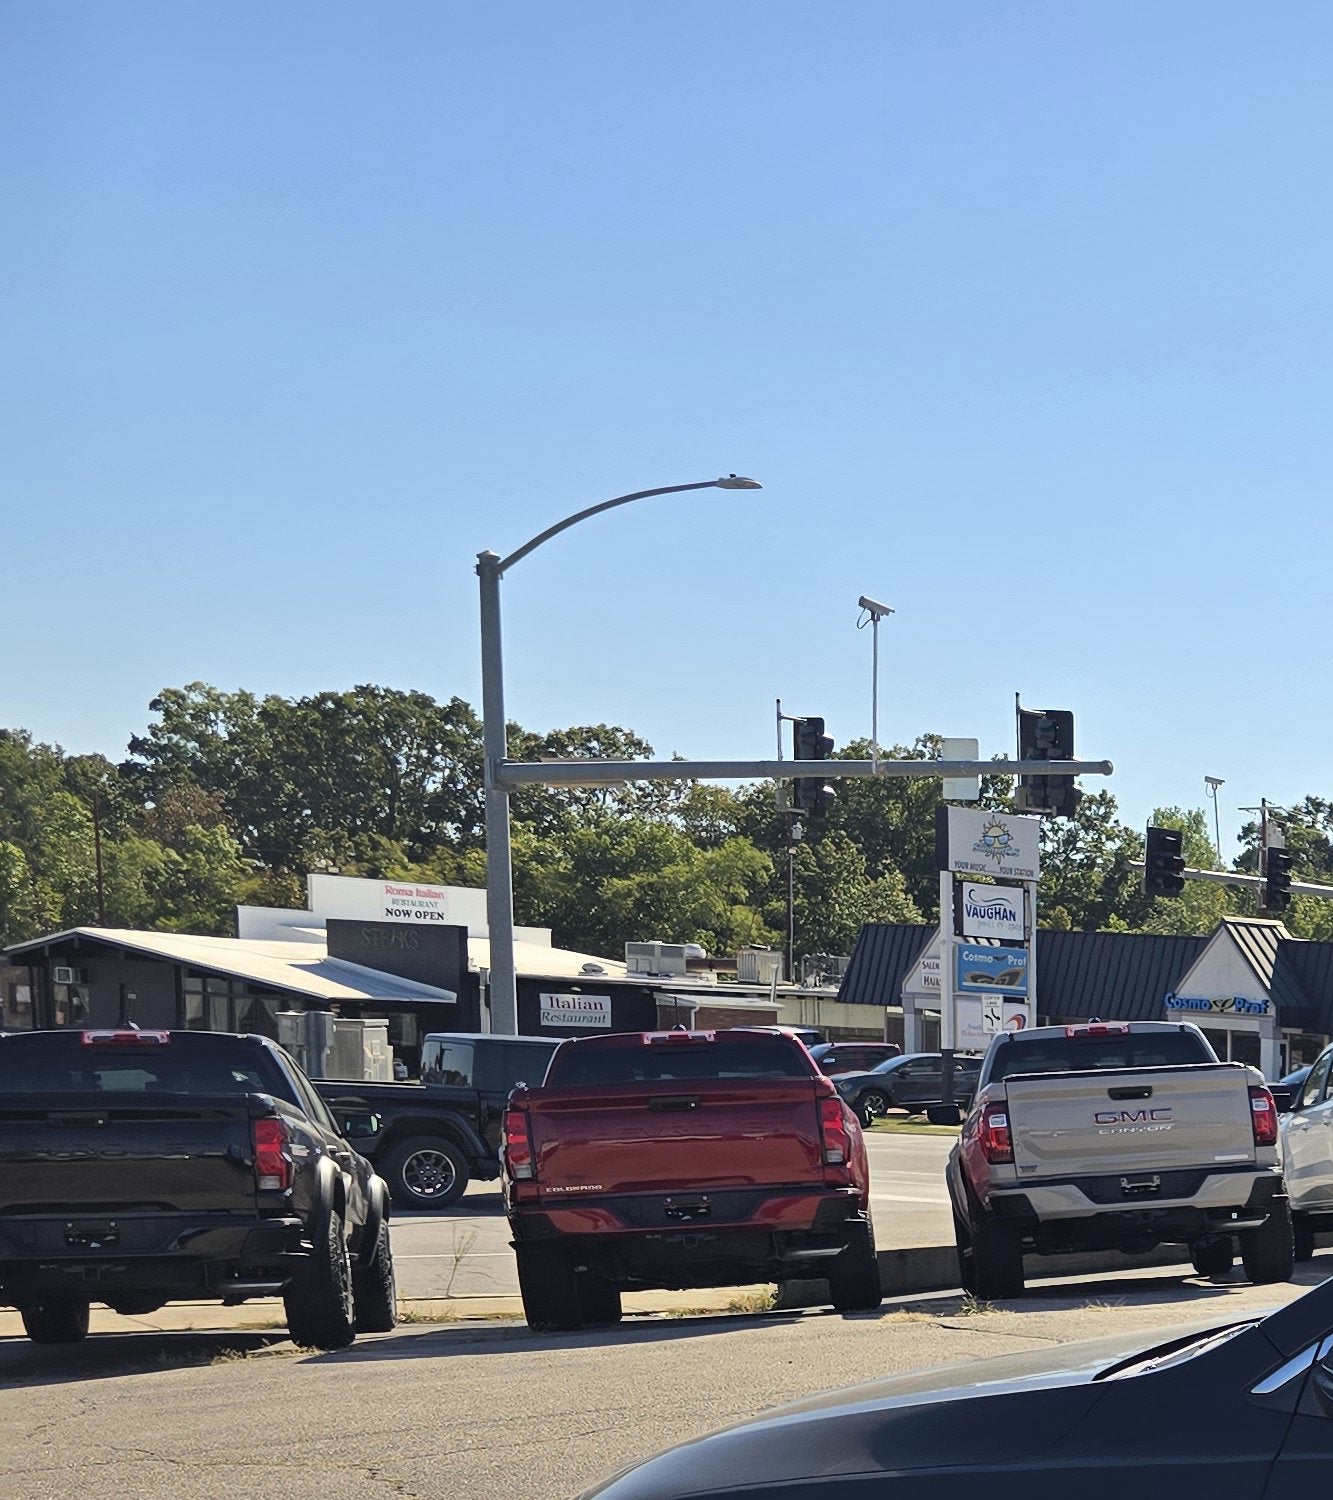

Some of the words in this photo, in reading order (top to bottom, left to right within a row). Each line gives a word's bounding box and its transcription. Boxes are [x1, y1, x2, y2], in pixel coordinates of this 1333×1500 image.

[385, 885, 414, 897] Roma
[416, 888, 445, 899] Italian
[391, 898, 438, 909] RESTAURANT
[385, 907, 413, 918] NOW
[415, 910, 445, 921] OPEN
[965, 904, 1016, 922] VAUGHAN
[962, 950, 994, 963] Cosmo
[549, 995, 604, 1011] Italian
[1164, 992, 1213, 1011] Cosmo
[1233, 996, 1270, 1014] Prof
[541, 1011, 607, 1024] Restaurant
[1094, 1107, 1173, 1126] GMC
[545, 1184, 603, 1193] COLORADO
